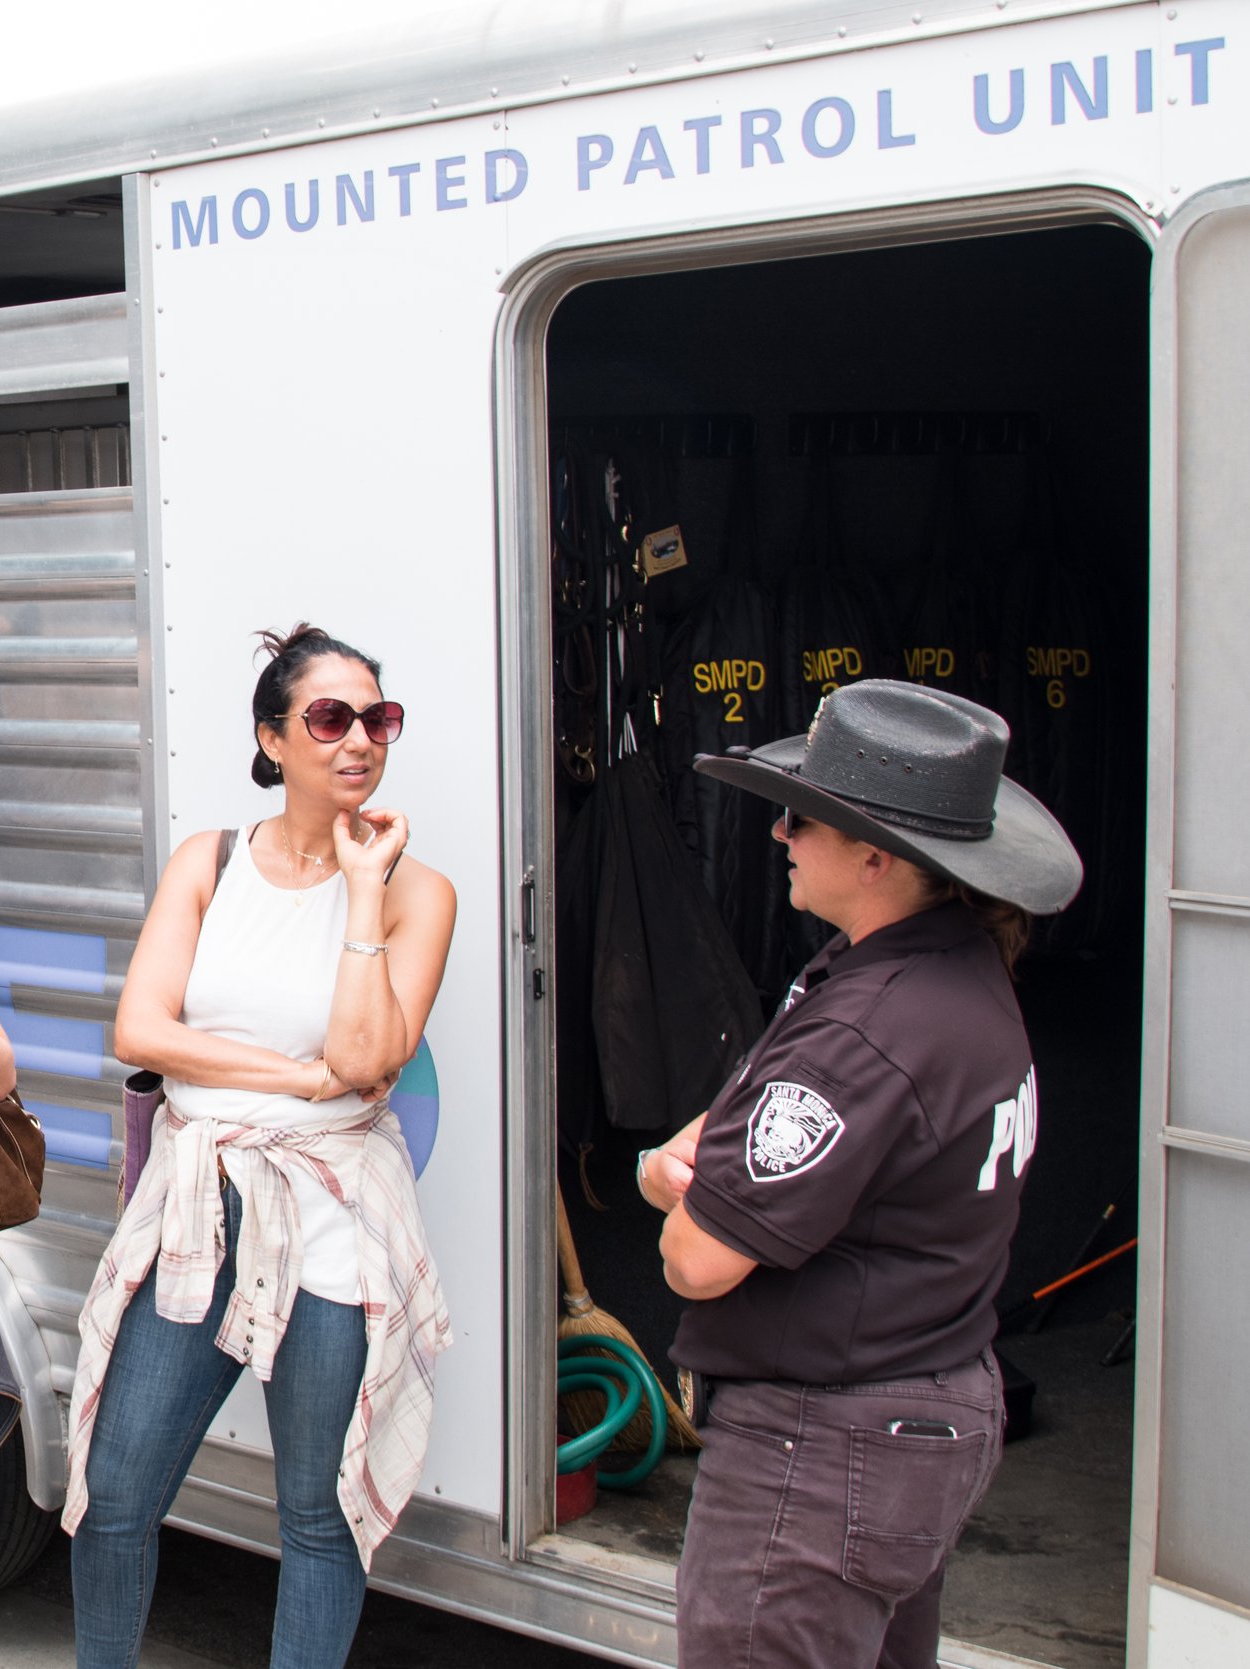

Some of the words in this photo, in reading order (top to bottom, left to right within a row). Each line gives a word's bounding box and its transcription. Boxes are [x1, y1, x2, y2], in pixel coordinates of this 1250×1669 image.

[171, 148, 528, 249] MOUNTED
[578, 89, 917, 189] PATROL
[974, 36, 1227, 134] UNIT
[693, 658, 767, 694] SMPD
[803, 647, 863, 682] SMPD
[1026, 647, 1091, 677] SMPD
[723, 693, 745, 723] 2
[1046, 679, 1067, 709] 6
[770, 1085, 801, 1101] SANTA
[801, 1093, 838, 1130] MONICA
[751, 1147, 787, 1173] POLICE
